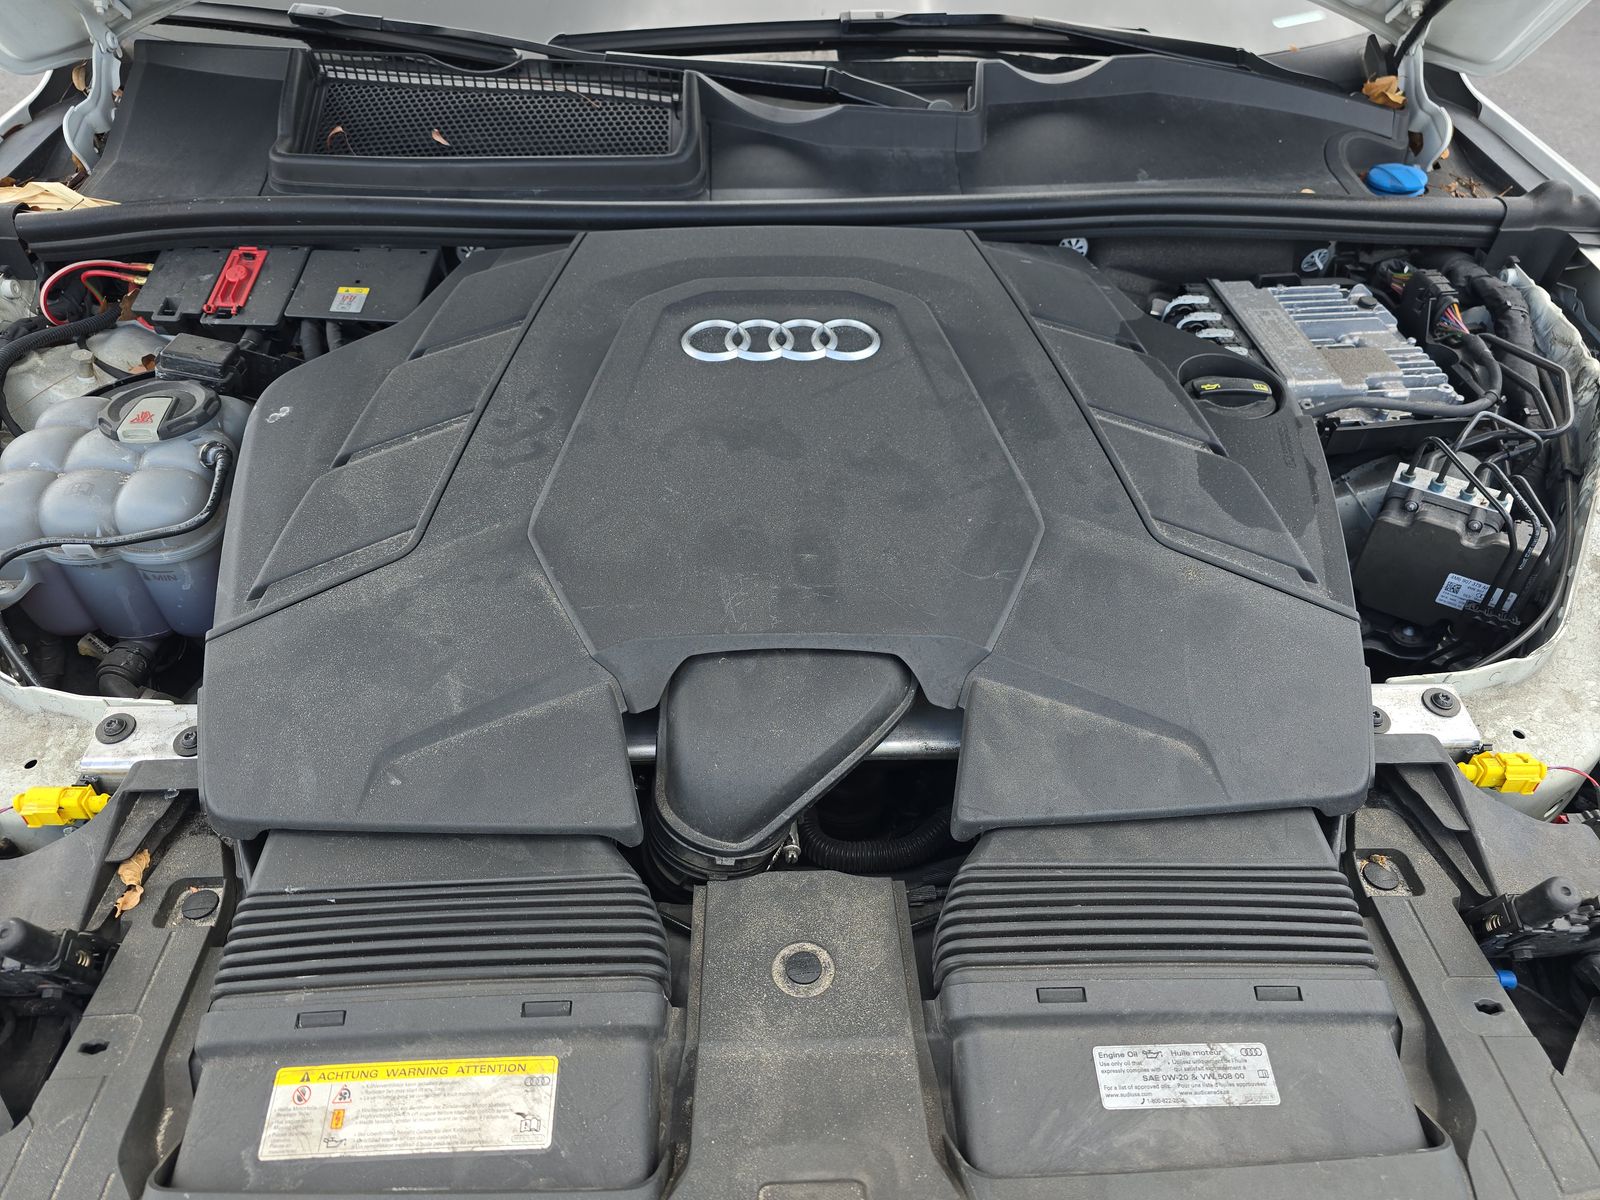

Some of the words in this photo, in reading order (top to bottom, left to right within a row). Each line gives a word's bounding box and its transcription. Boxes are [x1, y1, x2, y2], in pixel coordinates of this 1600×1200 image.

[153, 574, 178, 582] MIN
[317, 1070, 378, 1082] ACHTUNG
[386, 1066, 449, 1078] WARNING
[456, 1063, 527, 1074] ATTENTION
